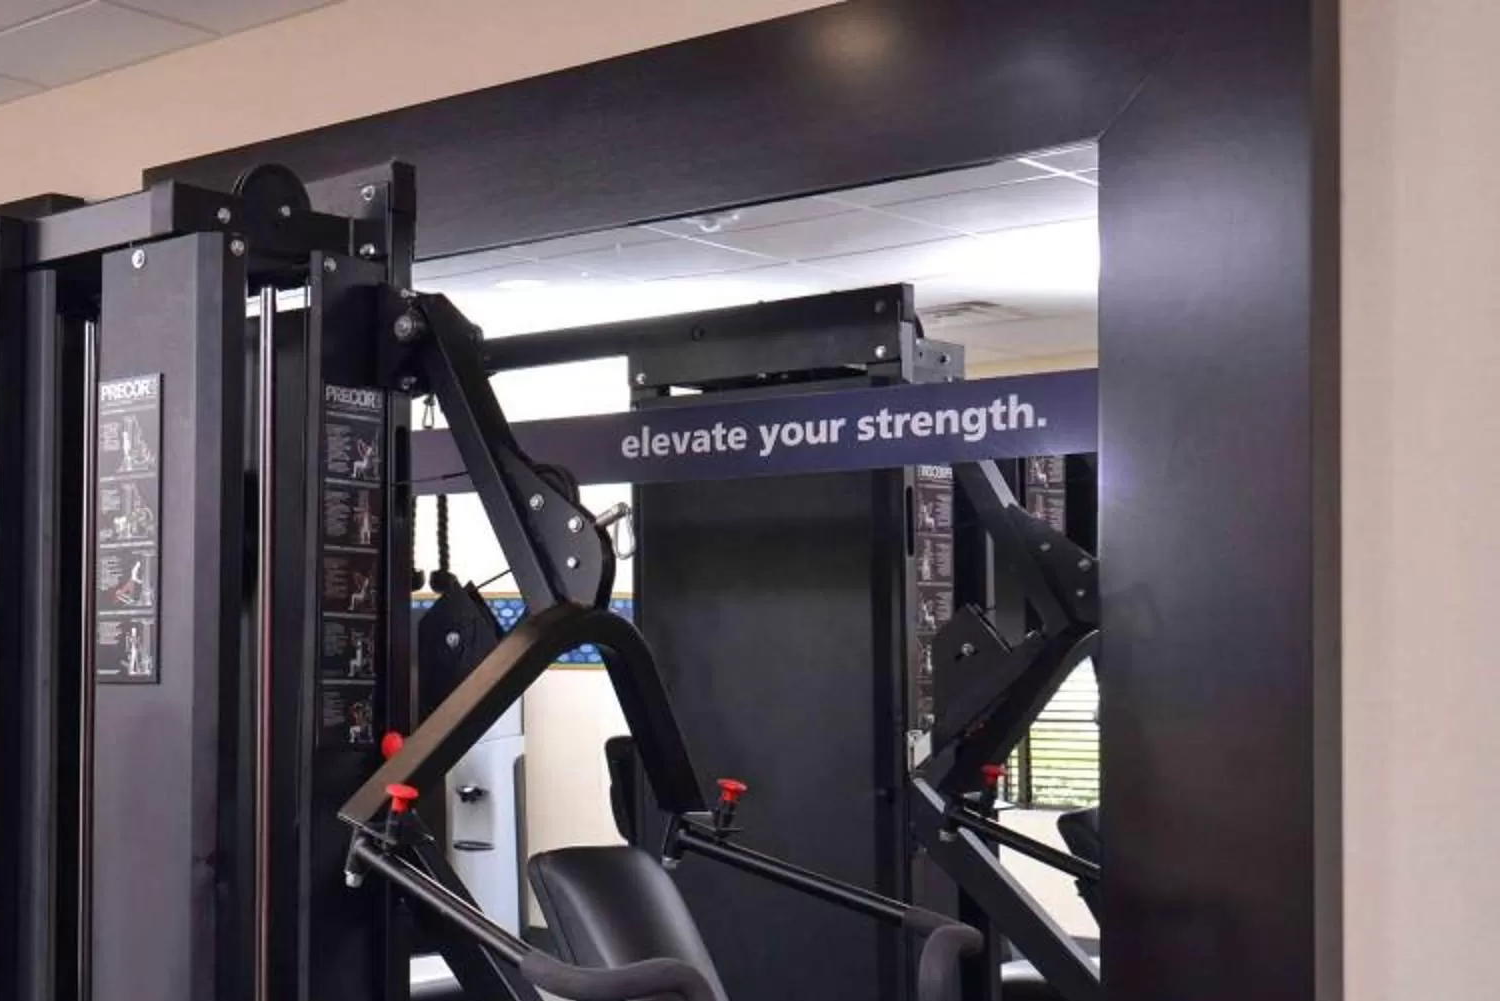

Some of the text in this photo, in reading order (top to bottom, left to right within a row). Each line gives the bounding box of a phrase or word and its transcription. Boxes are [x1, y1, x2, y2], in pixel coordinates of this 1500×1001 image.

[100, 380, 150, 401] PRECOR
[325, 386, 375, 408] PRECOR
[621, 395, 1047, 458] elevate your strength.
